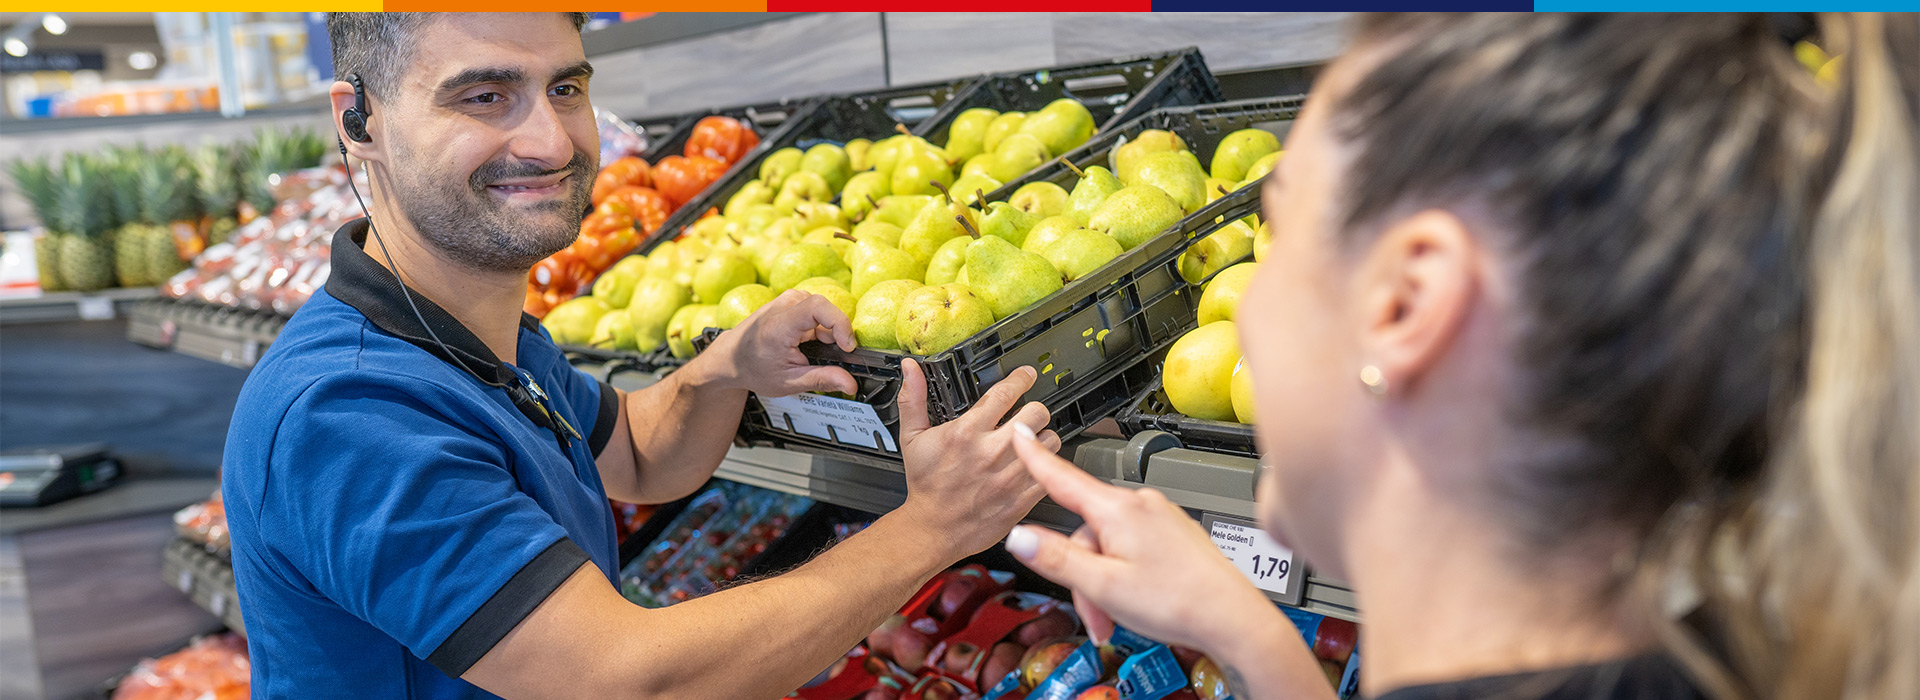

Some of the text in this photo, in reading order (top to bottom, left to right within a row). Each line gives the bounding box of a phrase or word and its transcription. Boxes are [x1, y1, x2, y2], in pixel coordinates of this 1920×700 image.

[799, 395, 816, 405] PERE
[838, 402, 864, 414] Williams
[858, 426, 869, 436] kg
[1212, 530, 1248, 543] Mele Golden
[1252, 554, 1289, 579] 1,79
